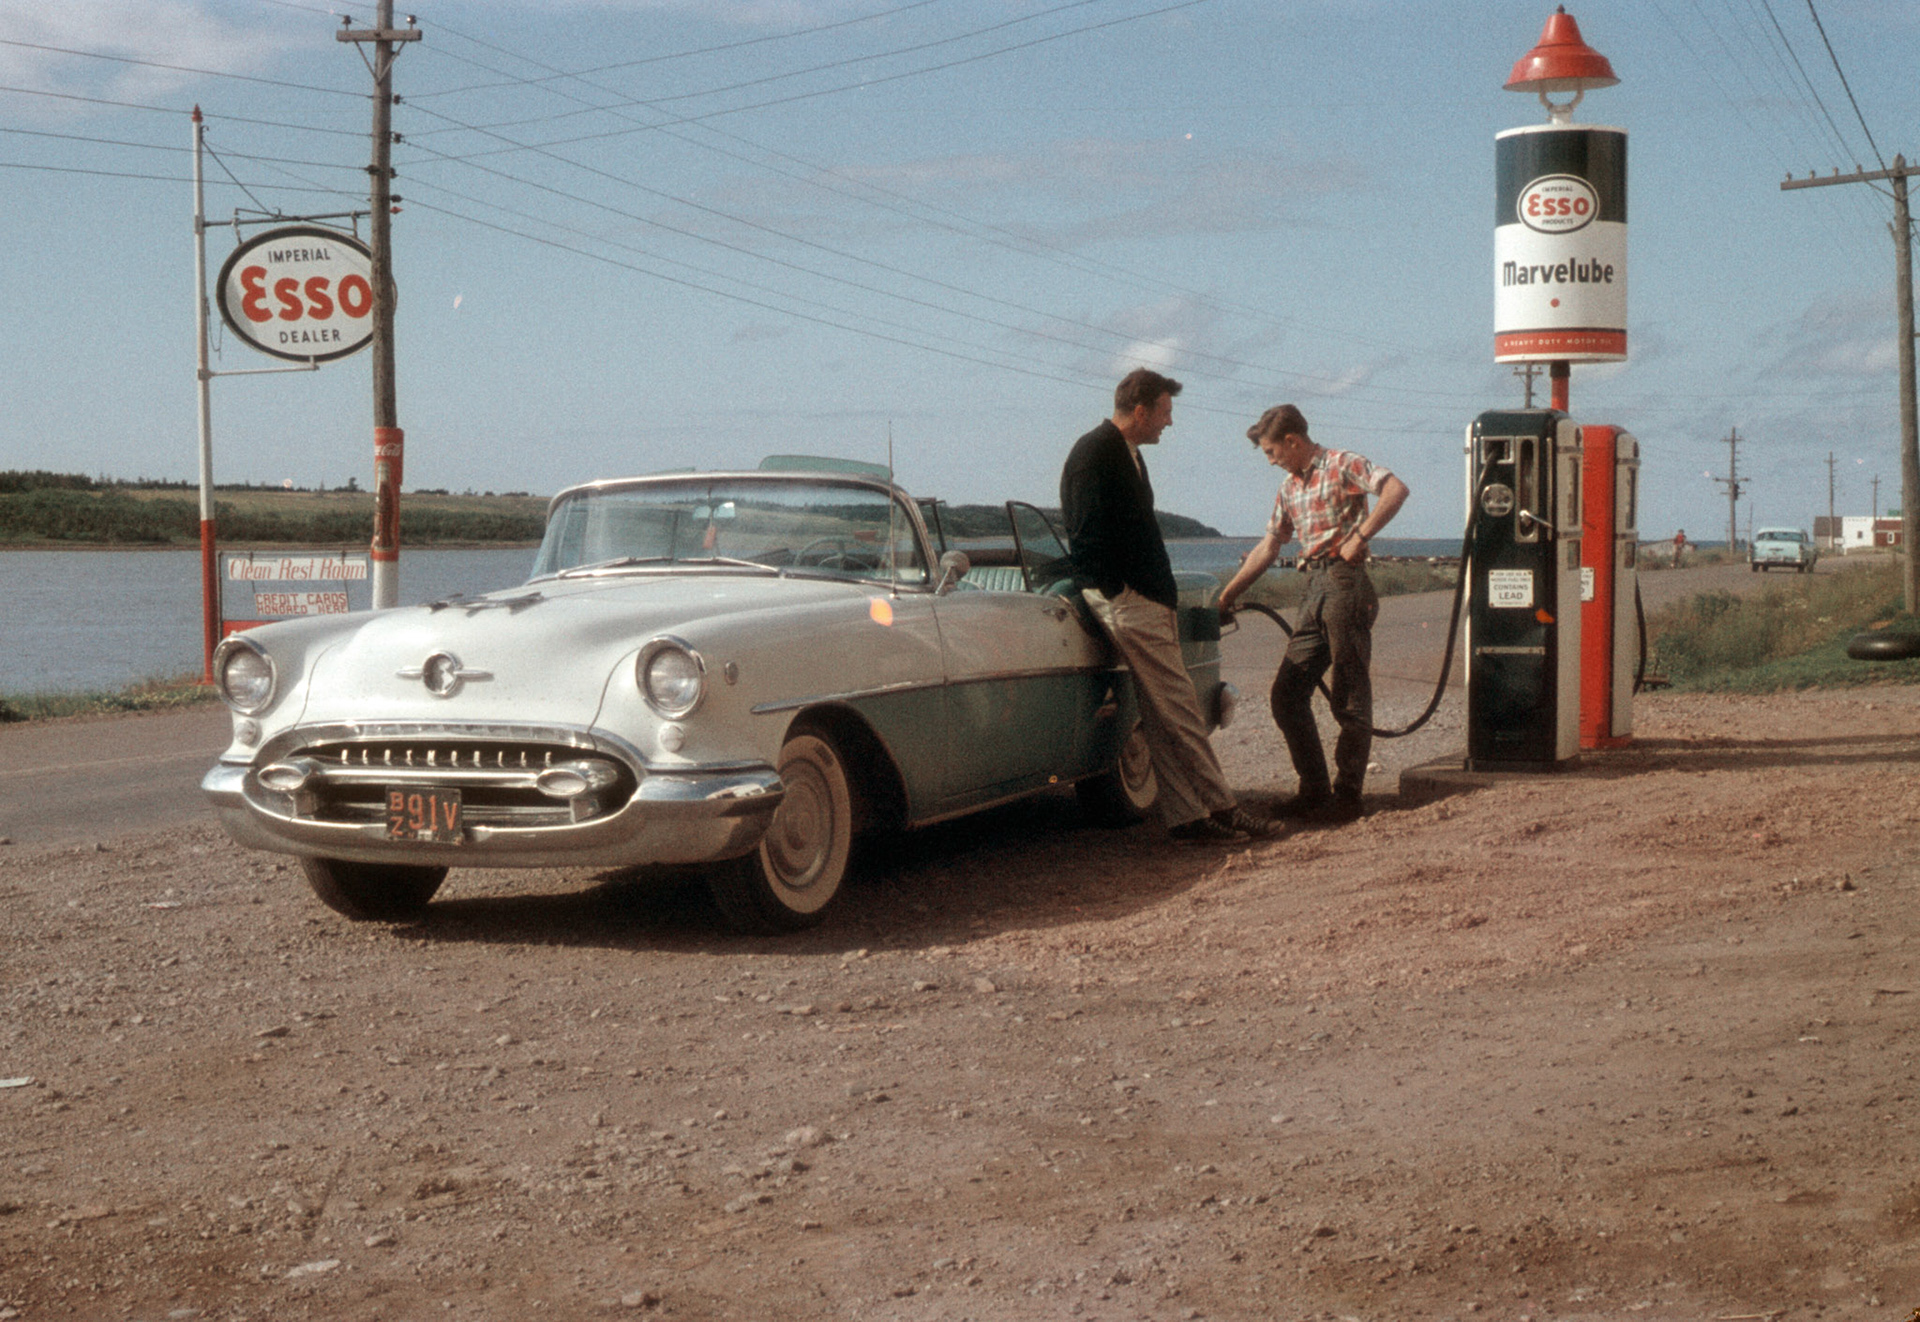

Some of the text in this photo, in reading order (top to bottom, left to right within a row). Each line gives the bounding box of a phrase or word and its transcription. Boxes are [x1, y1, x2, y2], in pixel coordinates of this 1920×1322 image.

[268, 248, 331, 264] IMPERIAL
[1503, 257, 1614, 287] Marvelube
[279, 329, 341, 344] DEALER
[230, 557, 365, 580] Clean Rest Room
[255, 593, 347, 606] CREDIT CARDS
[1498, 592, 1523, 600] LEAD
[257, 604, 347, 616] HONORED HERE
